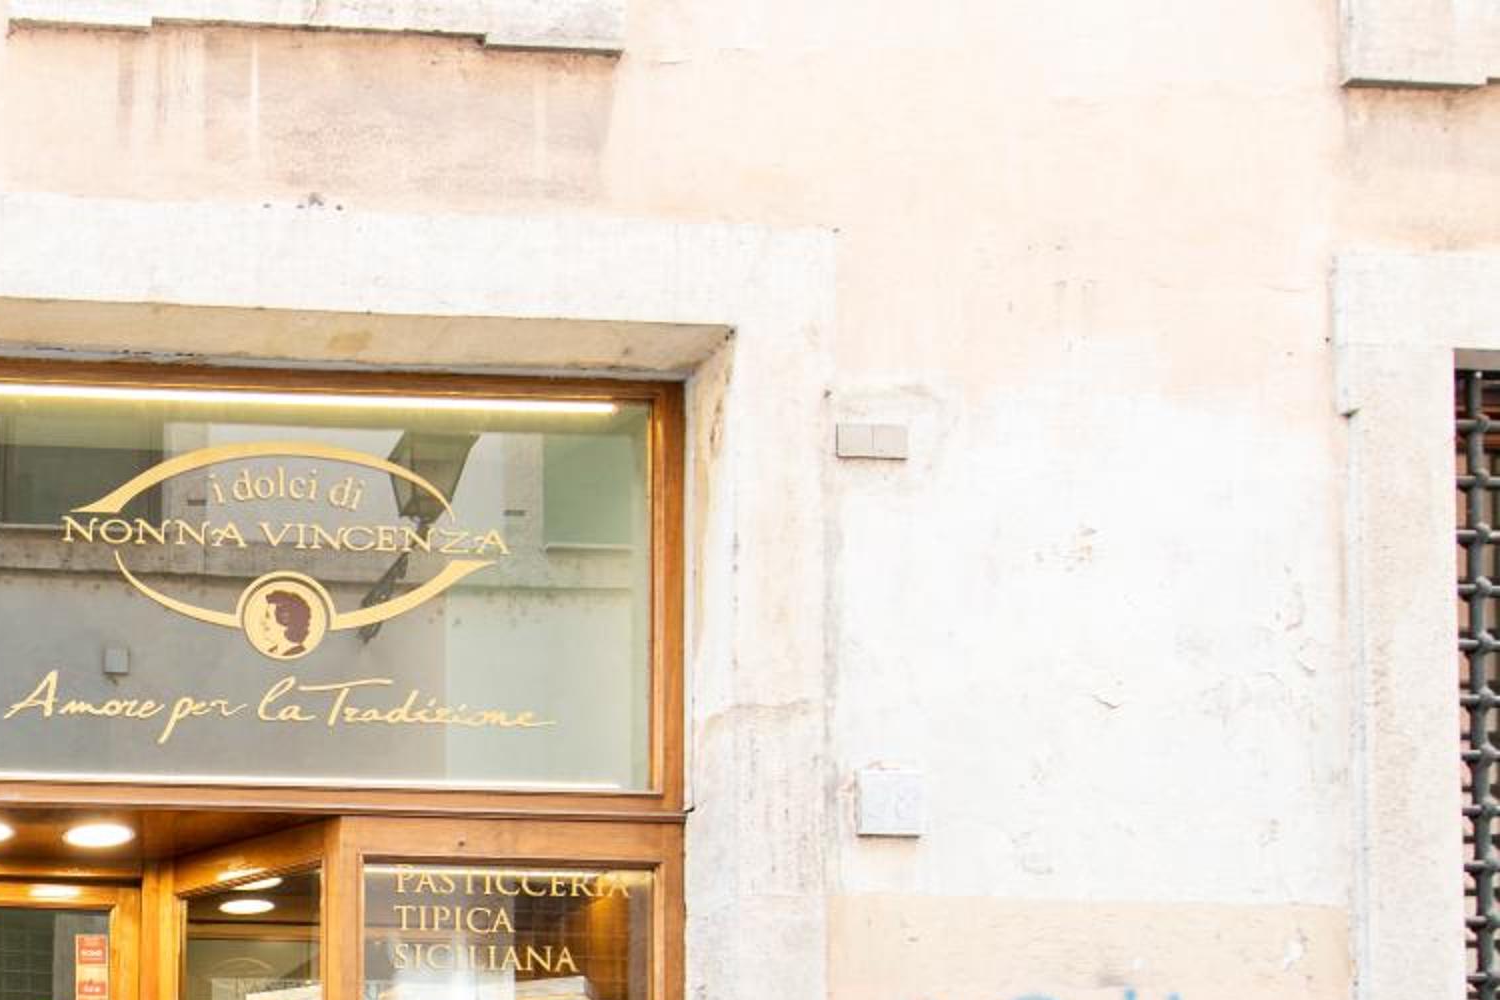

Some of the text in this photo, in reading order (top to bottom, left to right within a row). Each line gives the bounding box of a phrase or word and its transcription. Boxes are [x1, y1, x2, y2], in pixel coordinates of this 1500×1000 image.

[212, 466, 365, 511] i dolci di
[60, 514, 512, 556] NONNA VINCENZA
[2, 668, 558, 745] Amore per la Tradizione
[393, 865, 632, 898] PASTICCERIA
[393, 904, 517, 934] TIPICA
[393, 942, 581, 973] SICILIANA
